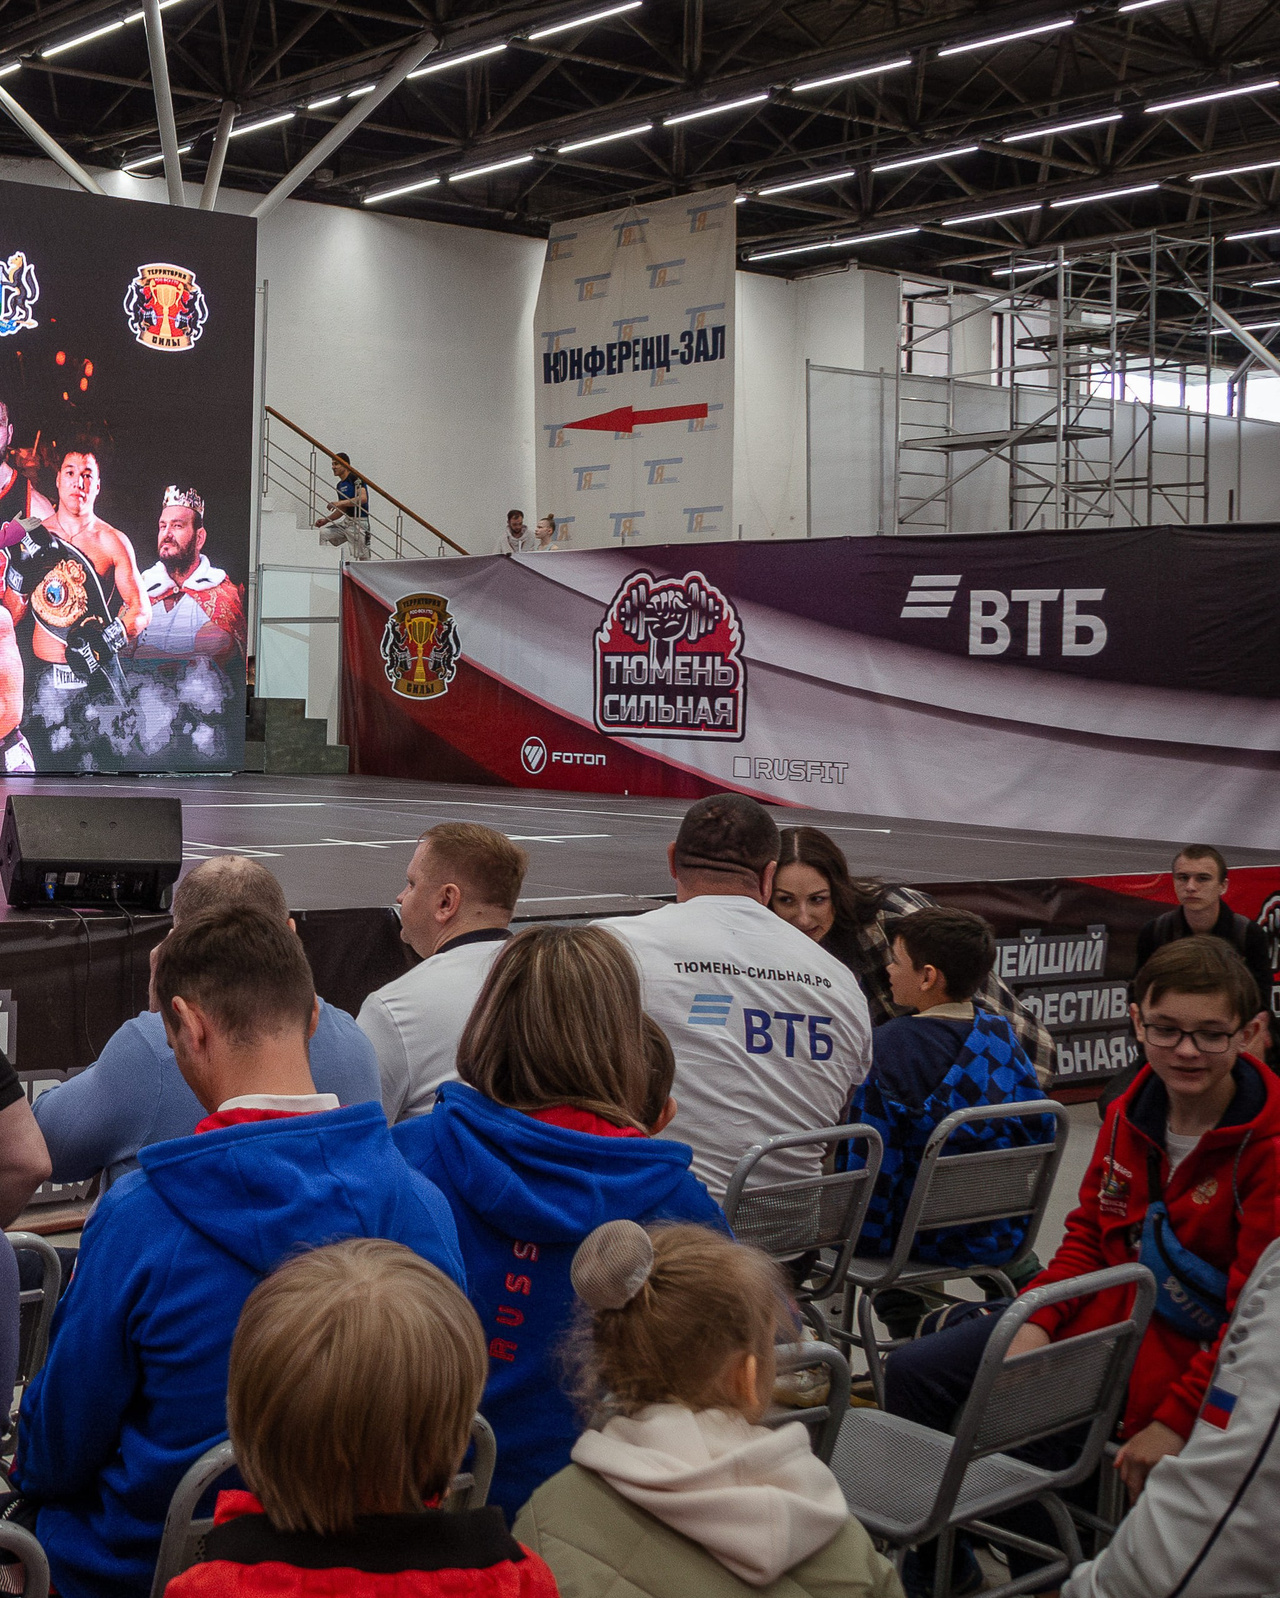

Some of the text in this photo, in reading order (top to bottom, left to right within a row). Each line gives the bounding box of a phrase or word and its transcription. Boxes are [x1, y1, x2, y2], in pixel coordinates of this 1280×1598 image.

[543, 325, 726, 385] КОНФЕРЕНЦ-ЗАЛ
[968, 588, 1108, 657] ВТБ
[604, 655, 735, 687] ТЮМЕНЬ
[603, 693, 734, 726] СИЛЬНАЯ
[754, 757, 849, 785] RUSFIT
[674, 961, 832, 989] ТЮМЕНЬ-СИЛЬНАЯ.РФ
[1021, 987, 1130, 1025] ФЕСТИВ
[743, 1008, 833, 1061] ВТБ
[1054, 1036, 1139, 1075] ЬНАЯ»
[488, 1240, 540, 1362] RUSS
